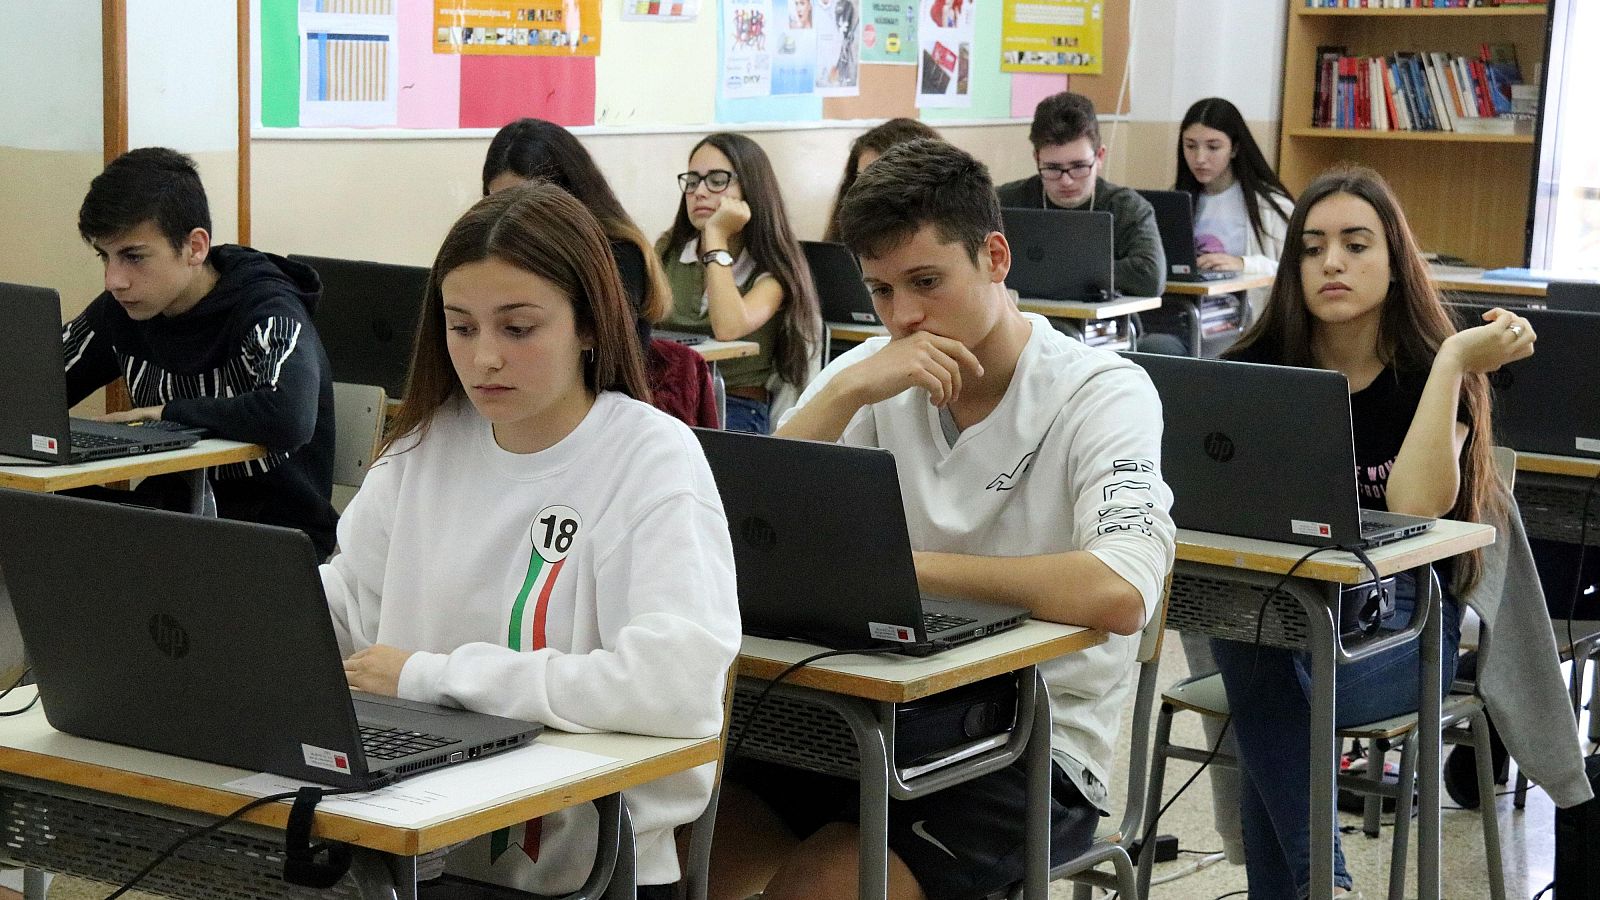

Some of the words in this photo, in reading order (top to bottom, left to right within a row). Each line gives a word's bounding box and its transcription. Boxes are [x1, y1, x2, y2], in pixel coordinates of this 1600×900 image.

[1207, 432, 1233, 463] hp
[1367, 456, 1397, 482] WOM
[540, 514, 578, 553] 18
[153, 613, 186, 660] hp
